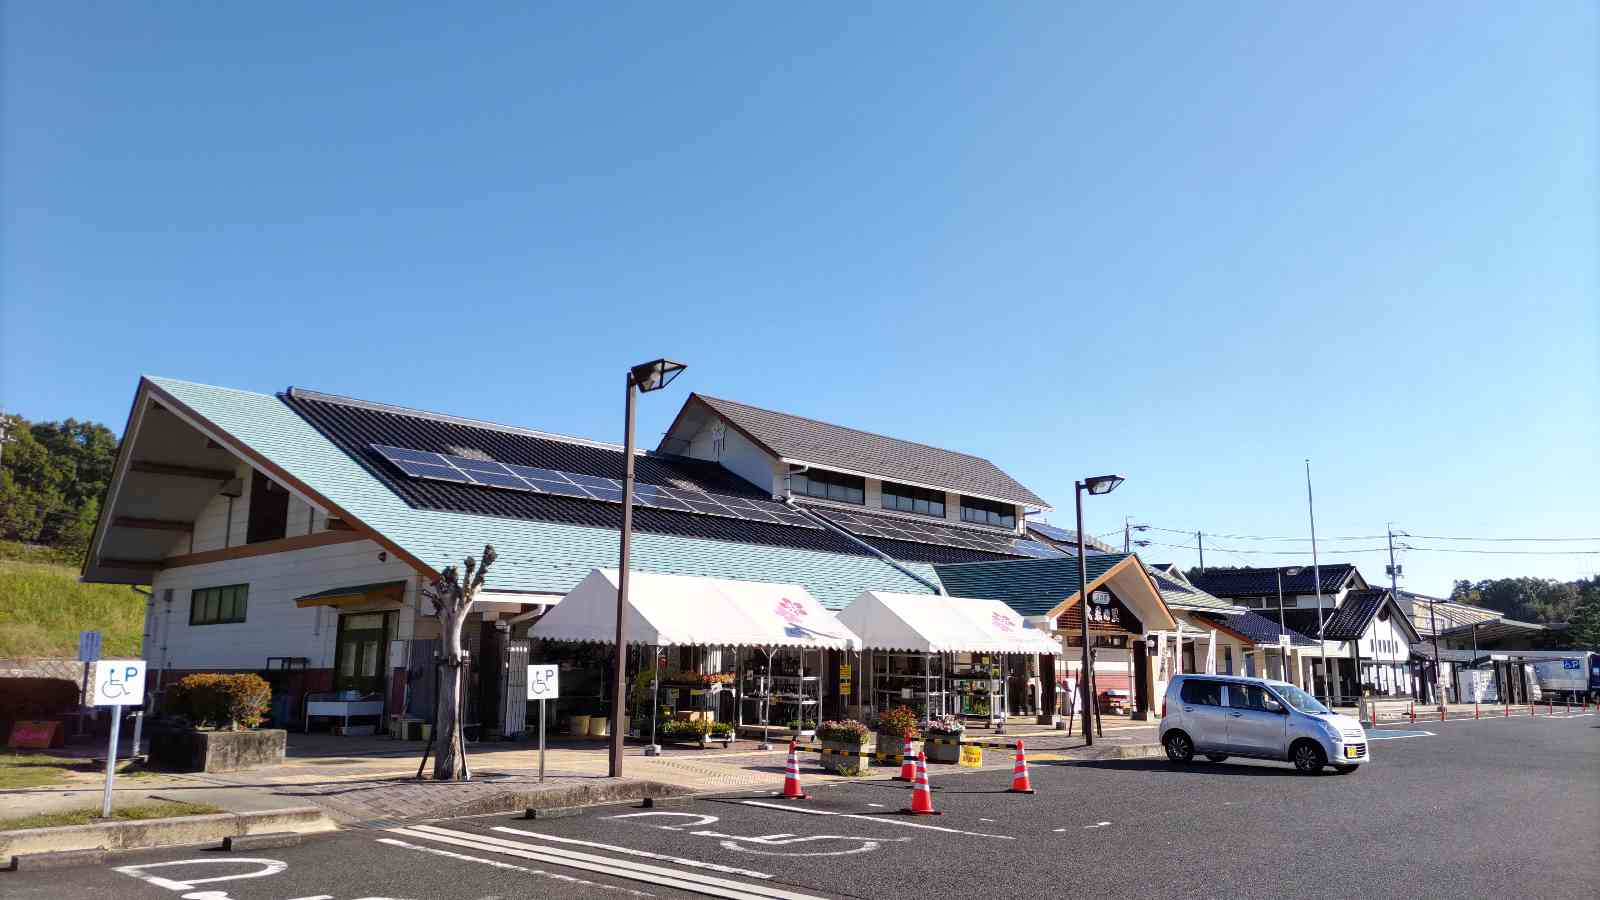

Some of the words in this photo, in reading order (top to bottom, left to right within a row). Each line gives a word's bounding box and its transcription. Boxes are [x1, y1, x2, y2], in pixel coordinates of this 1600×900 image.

[125, 667, 138, 682] P
[545, 669, 554, 681] P
[110, 858, 288, 890] P
